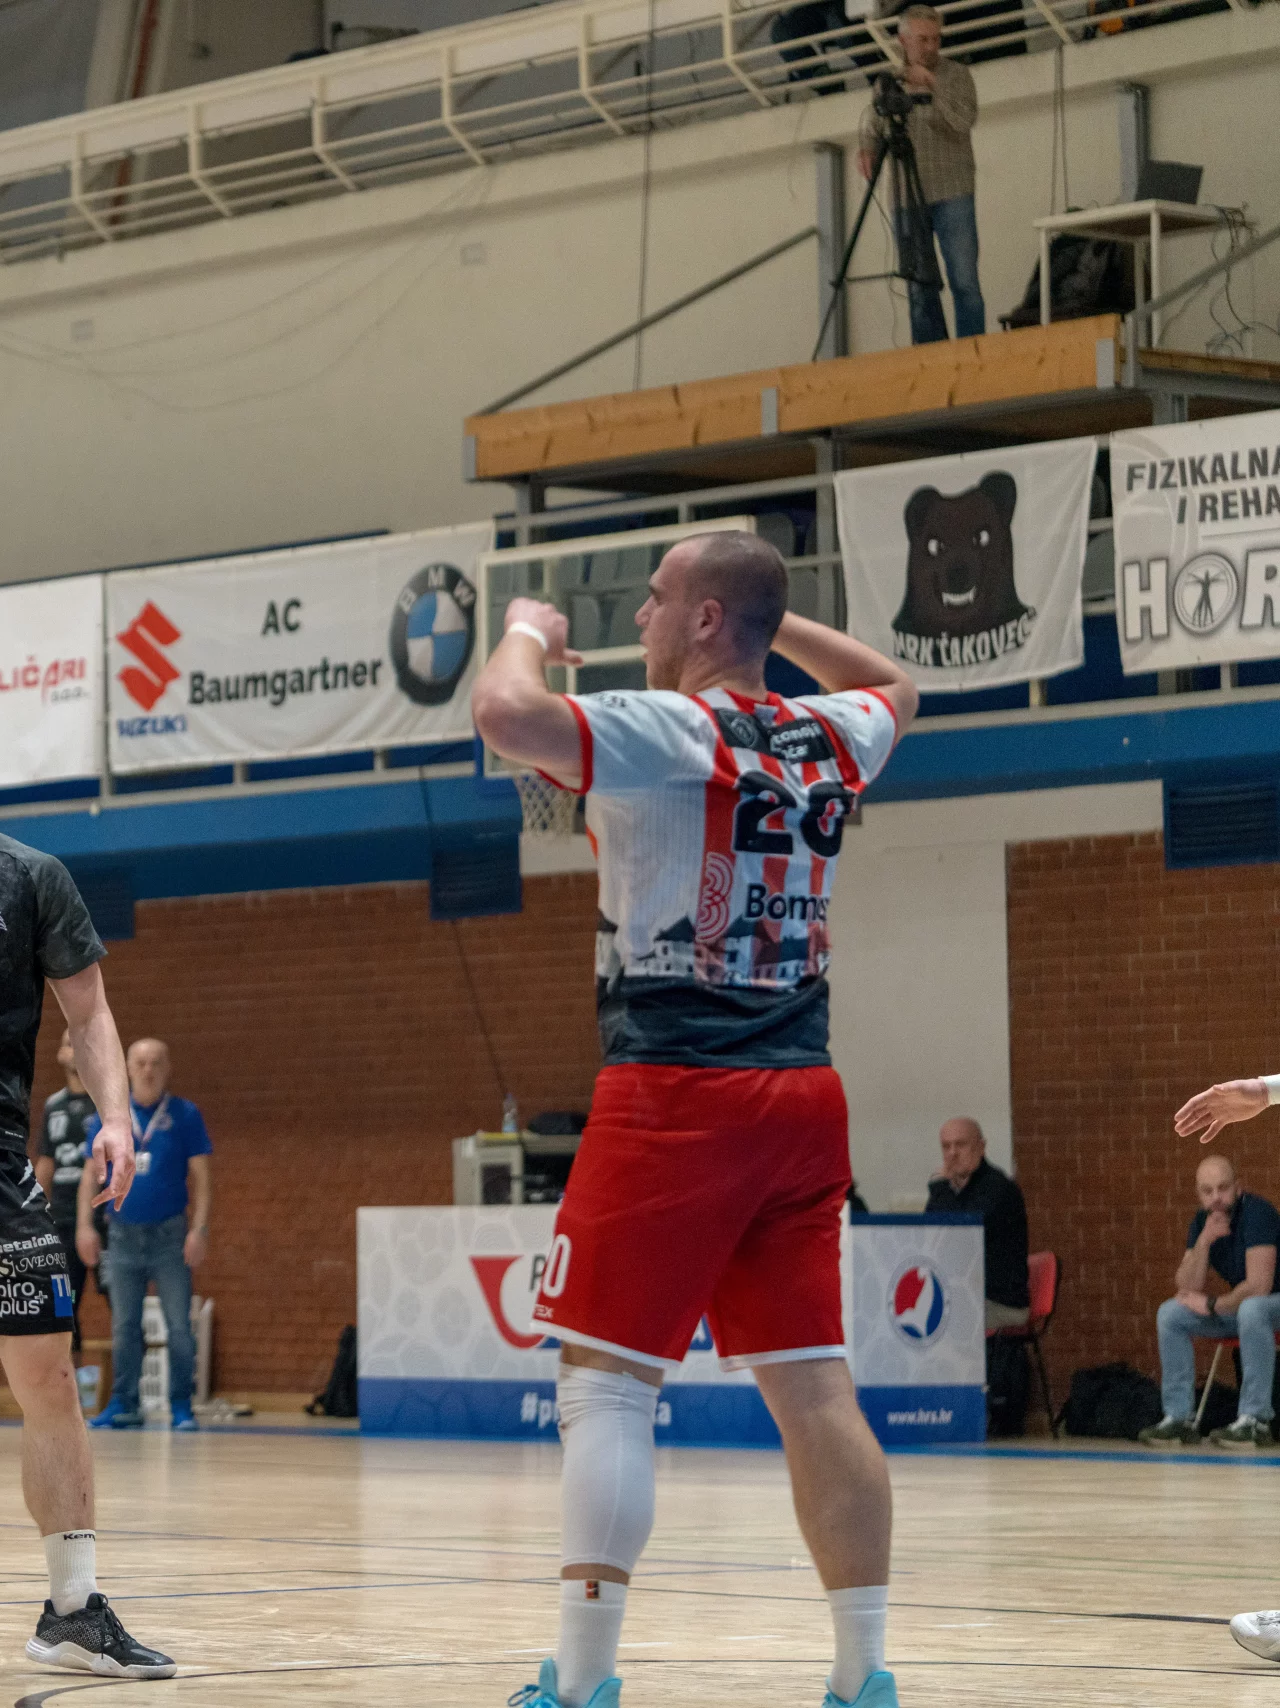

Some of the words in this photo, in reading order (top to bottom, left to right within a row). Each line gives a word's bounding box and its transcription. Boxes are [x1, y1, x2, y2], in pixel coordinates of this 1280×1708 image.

[1176, 495, 1188, 524] I
[261, 598, 302, 637] AC
[188, 657, 382, 706] Baumgartner
[117, 715, 187, 738] SUZUKI
